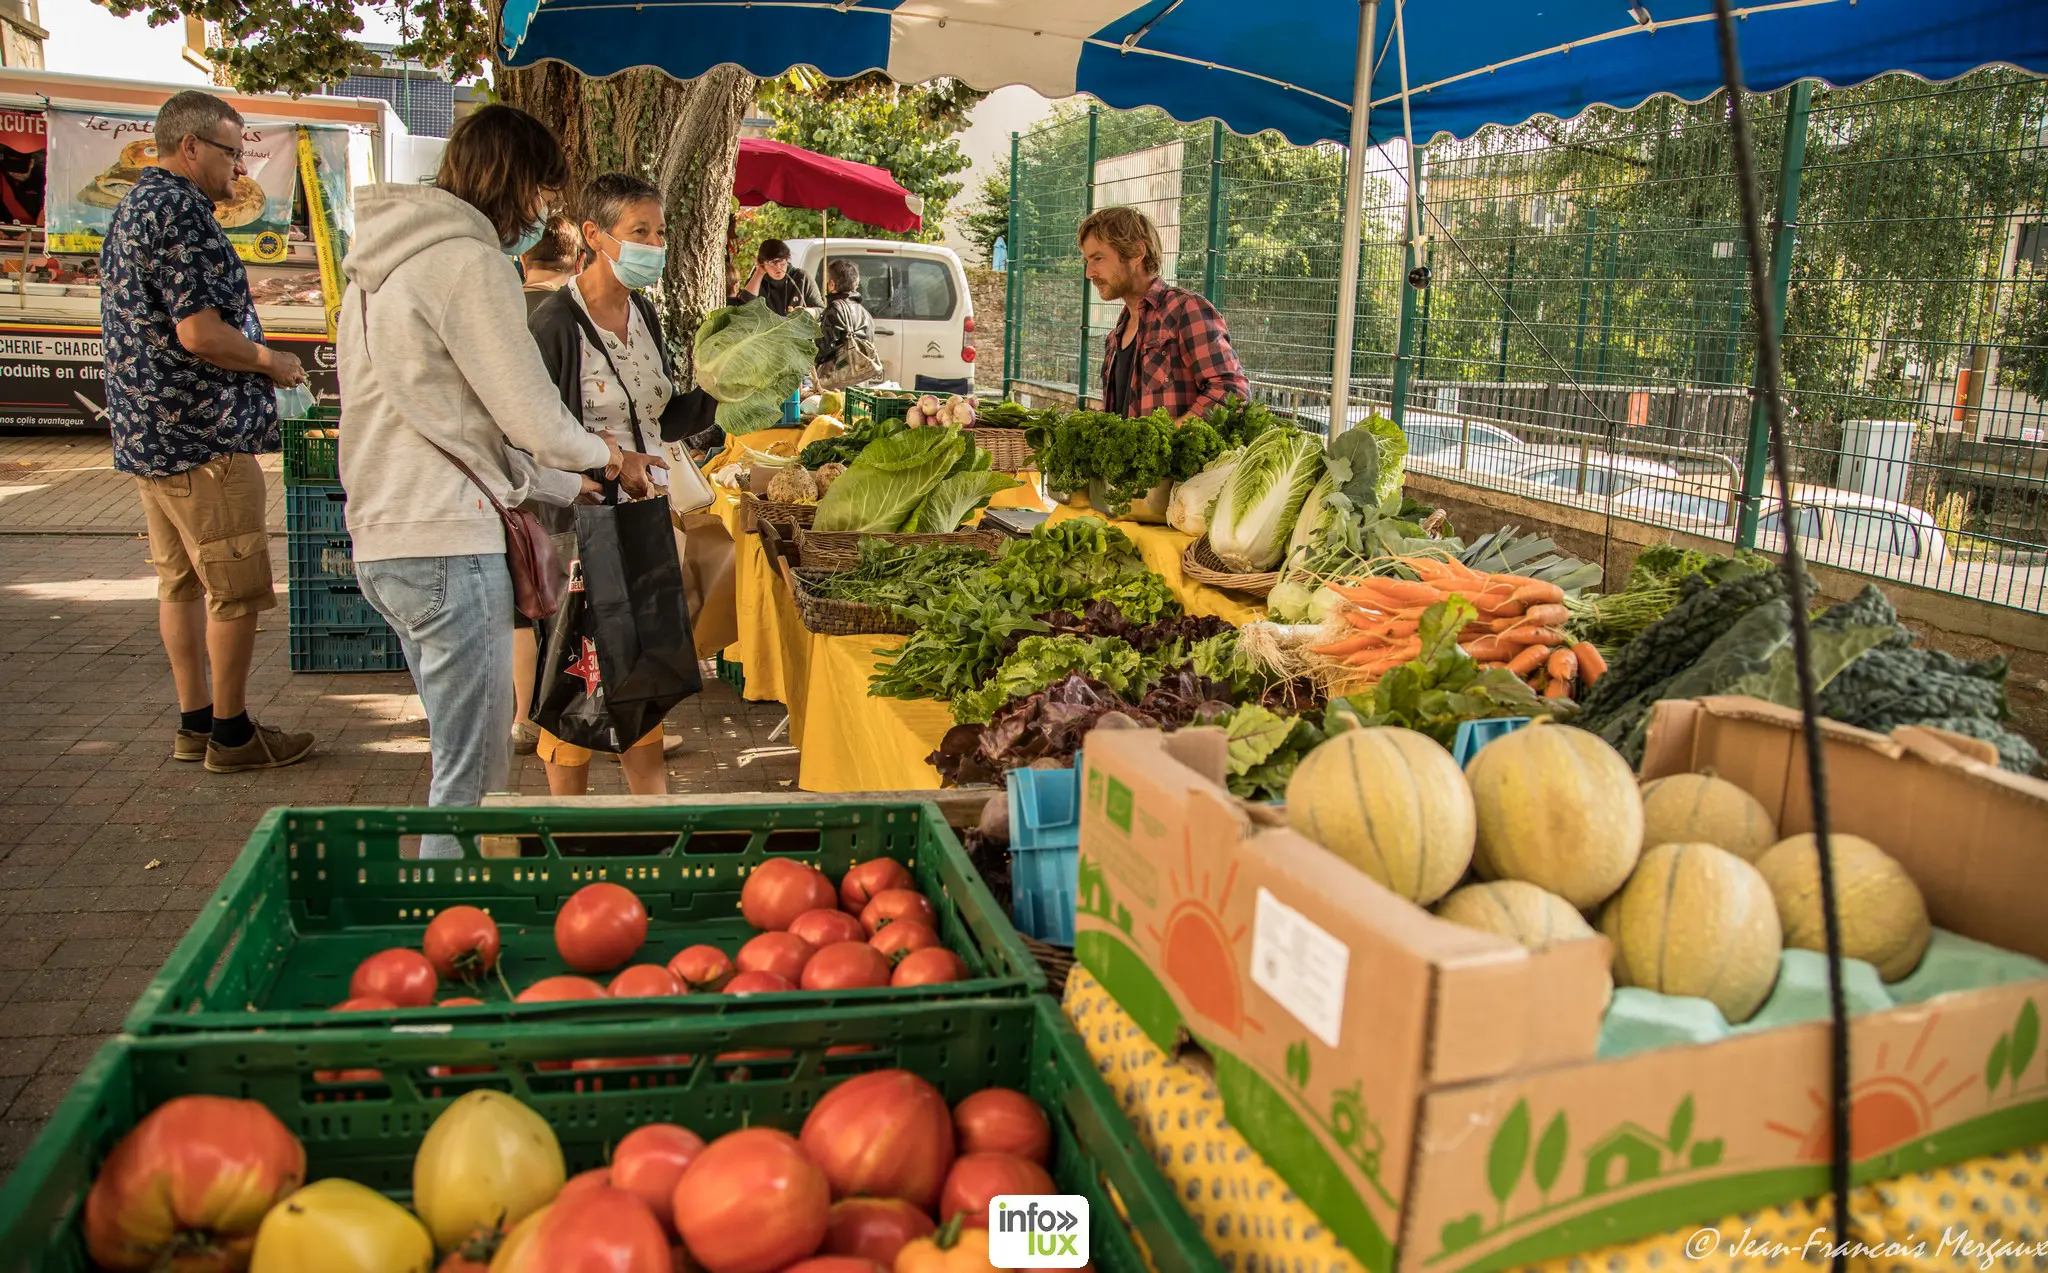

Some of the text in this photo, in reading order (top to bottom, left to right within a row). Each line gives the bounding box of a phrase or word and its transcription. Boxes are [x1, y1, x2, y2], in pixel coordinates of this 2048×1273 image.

[86, 116, 155, 139] Le pât
[55, 367, 74, 379] en
[16, 416, 36, 425] colis
[37, 417, 85, 427] avantageux
